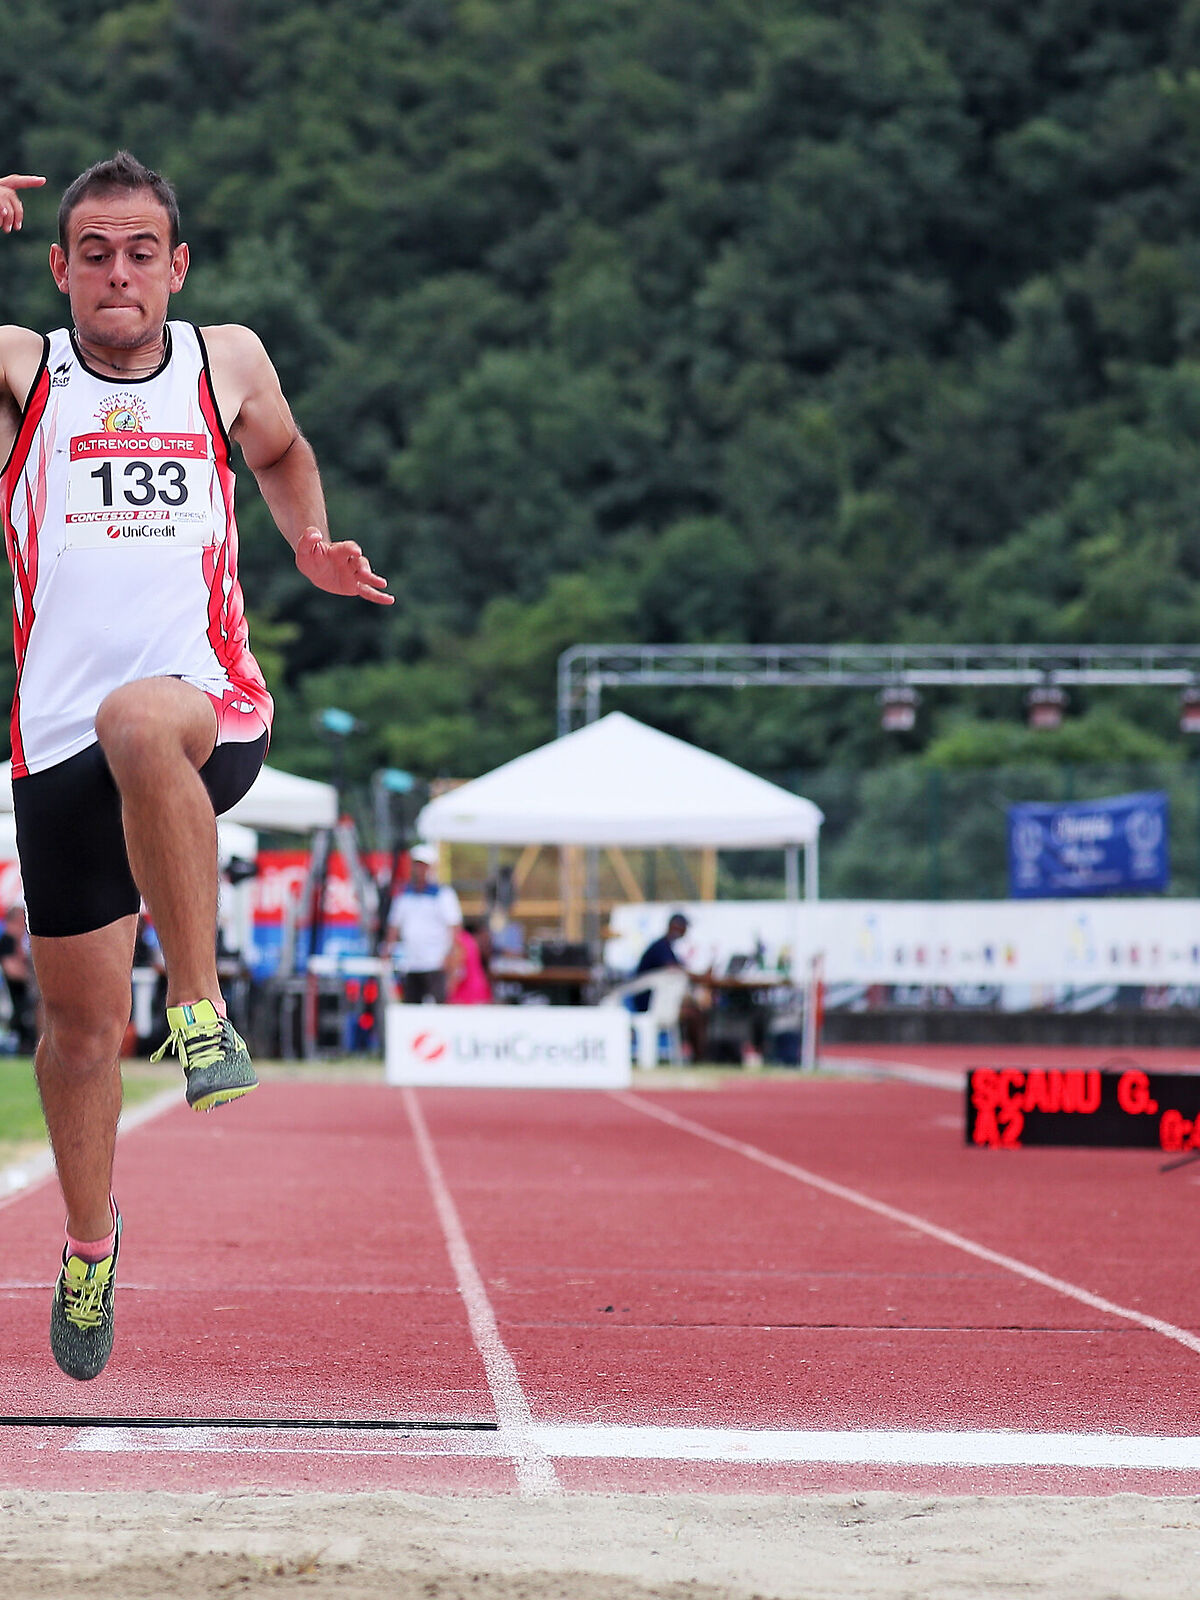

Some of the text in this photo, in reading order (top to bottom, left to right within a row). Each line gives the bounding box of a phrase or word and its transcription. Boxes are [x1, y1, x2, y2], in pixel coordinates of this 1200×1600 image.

[77, 436, 194, 452] OLTREMODOLTRE
[90, 461, 188, 507] 133
[70, 511, 135, 523] CONCESIO
[136, 511, 168, 521] 2021
[122, 525, 176, 538] UniCredit
[453, 1030, 607, 1063] UniCredit
[1117, 1069, 1159, 1115] G.
[973, 1106, 1024, 1150] A2
